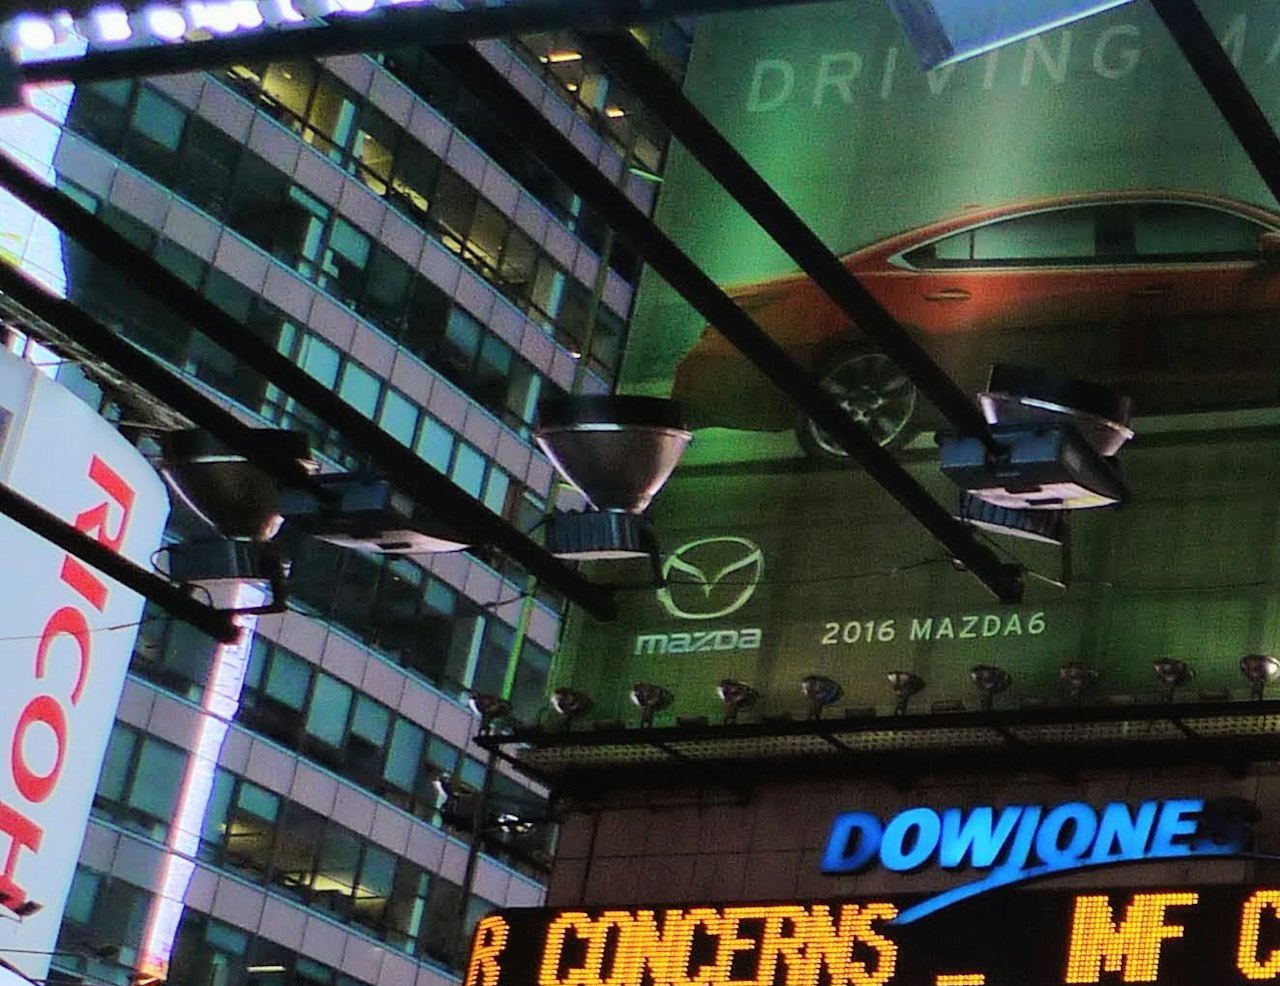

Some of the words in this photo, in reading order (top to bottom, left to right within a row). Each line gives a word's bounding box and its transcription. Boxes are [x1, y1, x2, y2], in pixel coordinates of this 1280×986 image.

[0, 455, 136, 915] RICOH
[822, 619, 895, 645] 2016
[909, 611, 1046, 642] MAZDA6
